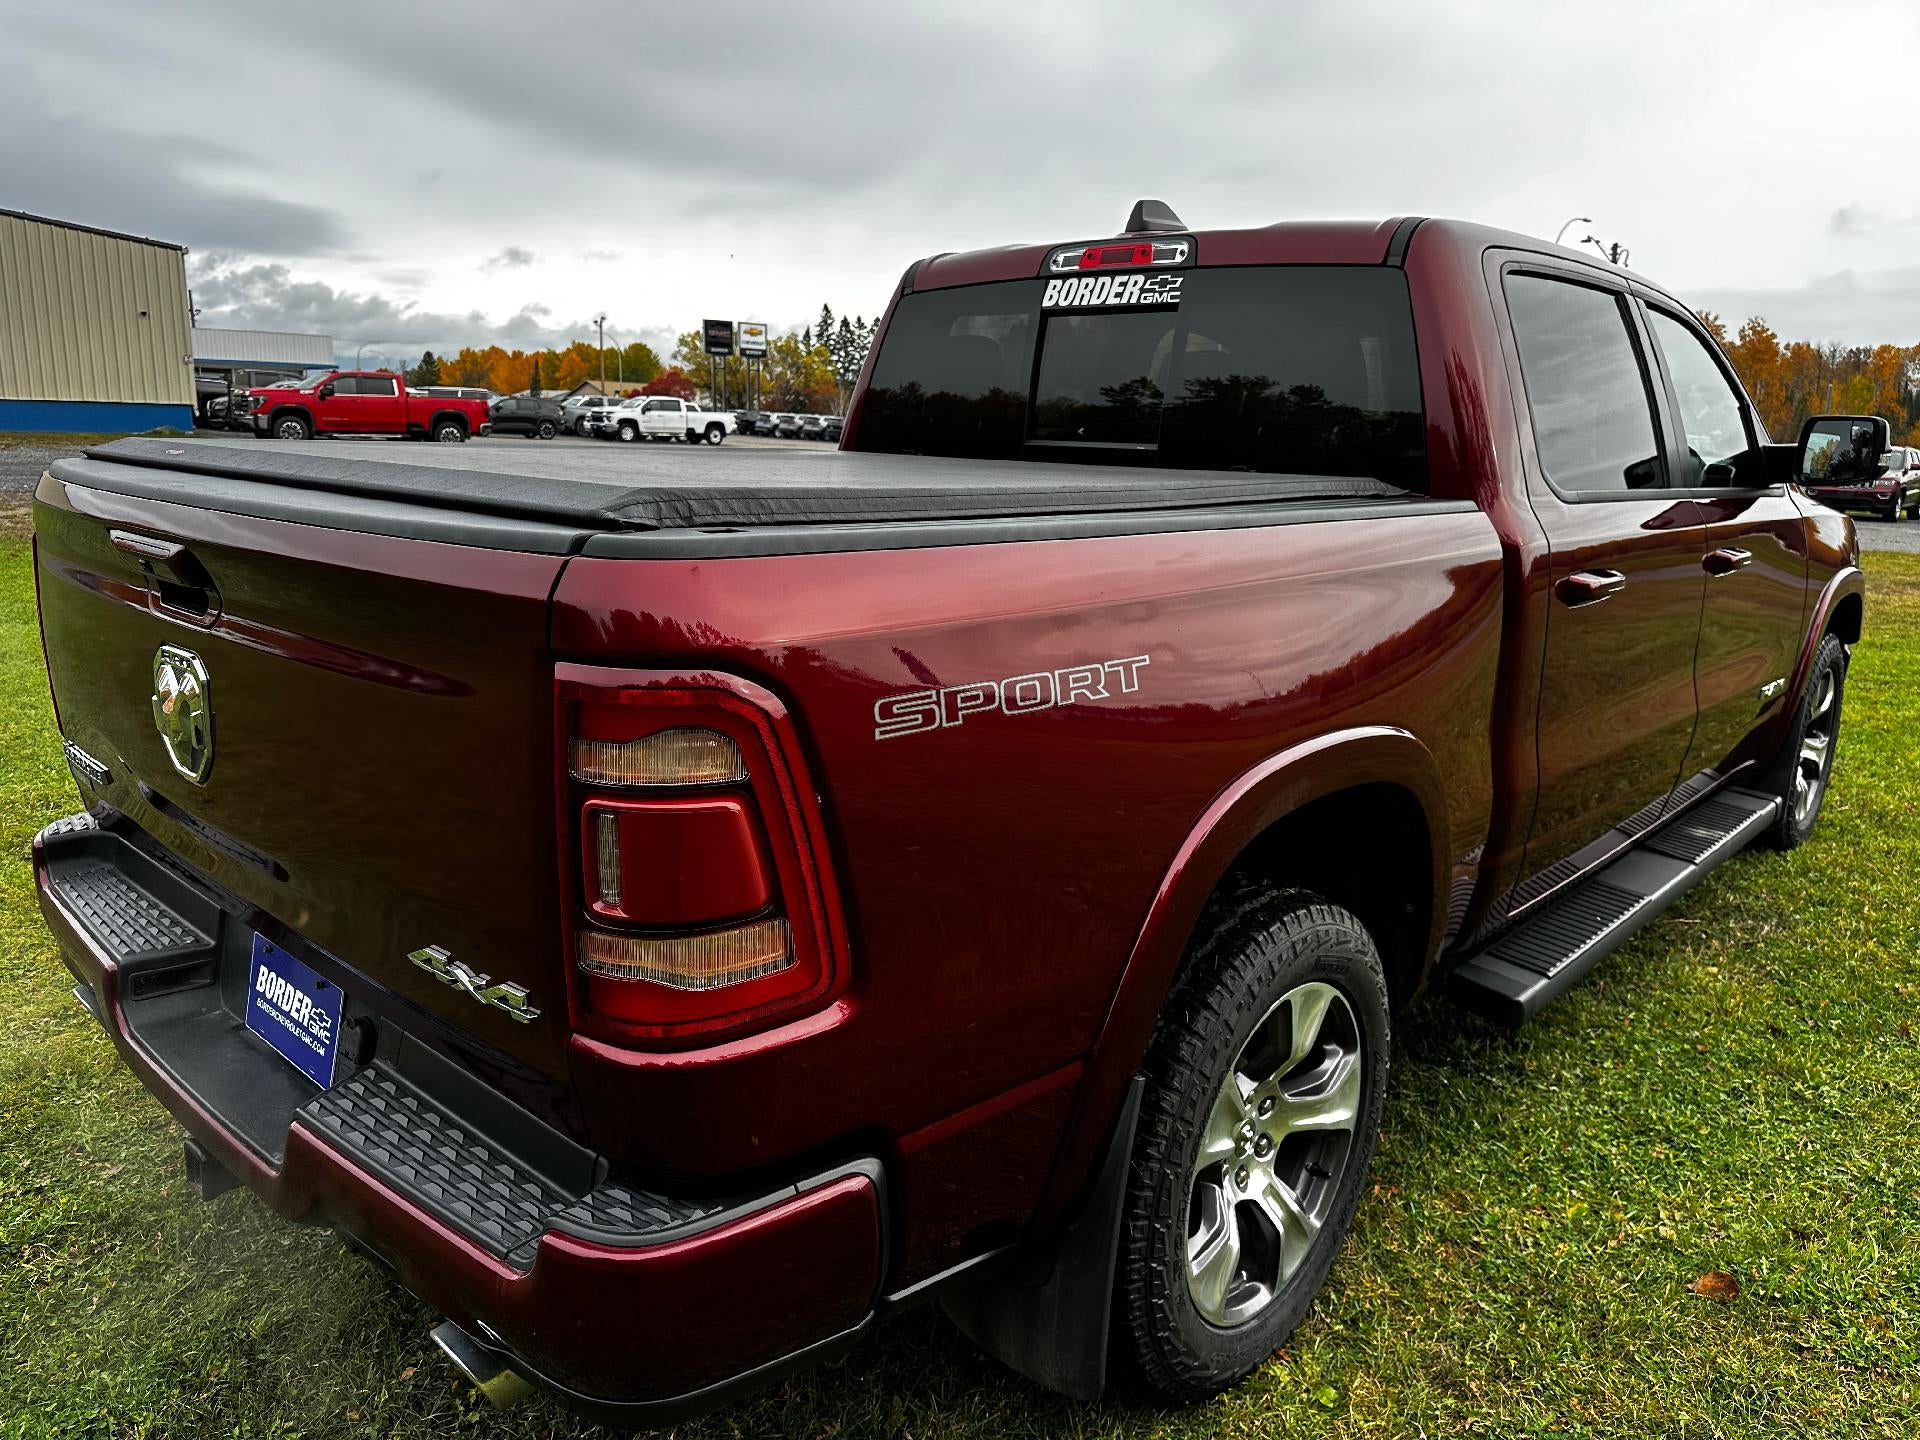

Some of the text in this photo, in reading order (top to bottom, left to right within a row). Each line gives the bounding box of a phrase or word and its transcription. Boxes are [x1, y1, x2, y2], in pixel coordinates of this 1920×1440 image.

[1042, 274, 1146, 307] BORDER
[1140, 291, 1182, 304] GMC
[874, 654, 1151, 741] SPORT
[255, 964, 313, 1028] BORDER
[308, 1019, 331, 1045] GMC
